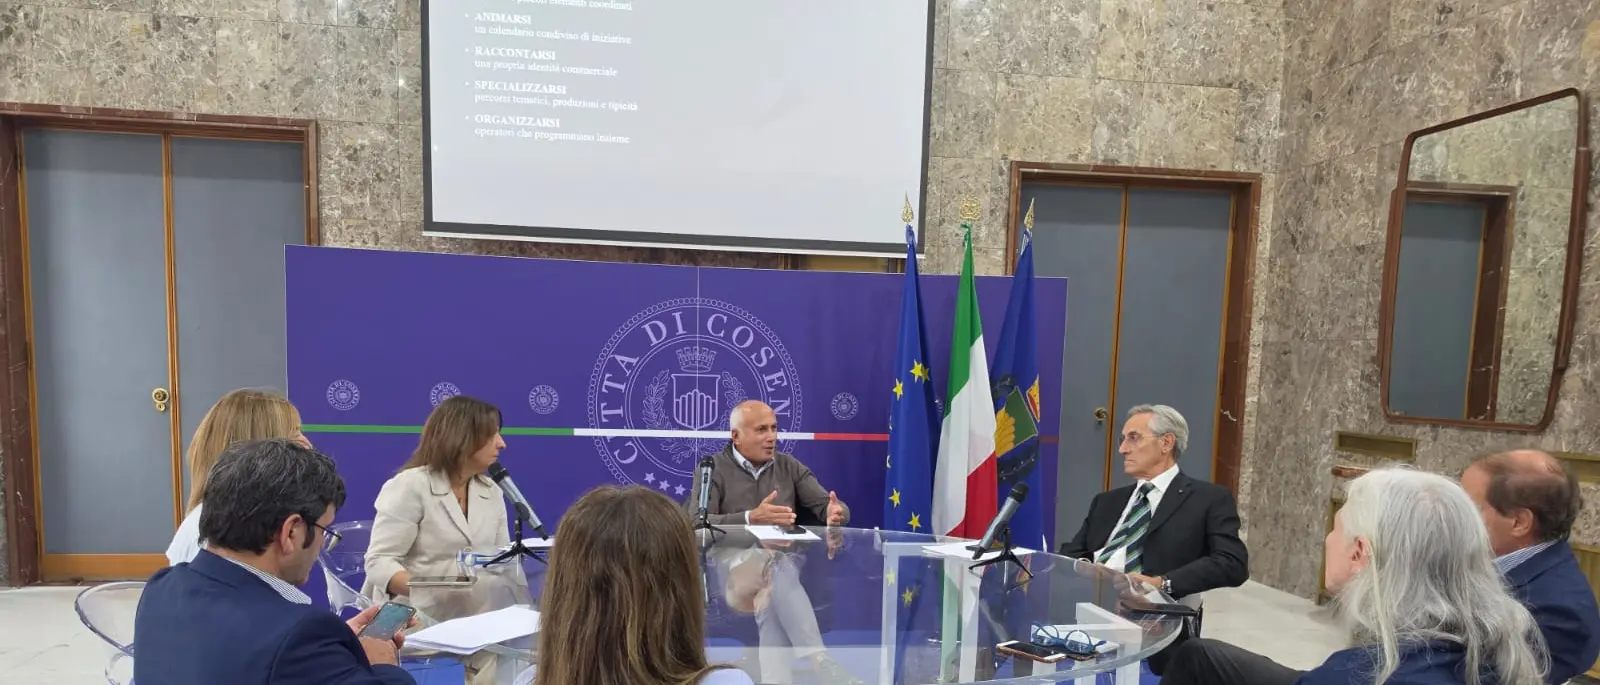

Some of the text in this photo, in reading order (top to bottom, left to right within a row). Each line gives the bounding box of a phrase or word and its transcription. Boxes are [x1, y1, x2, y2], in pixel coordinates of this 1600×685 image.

[474, 12, 532, 25] ANIMARSI
[474, 24, 632, 44] un calendario condiviso di iniziative
[474, 46, 556, 60] RACCONTARSI
[474, 60, 618, 77] una propria identità commerciale
[474, 80, 566, 95] SPECIALIZZARSI
[474, 94, 511, 104] percorsi
[552, 97, 599, 109] produzioni
[474, 113, 561, 128] ORGANIZZARSI
[474, 127, 515, 138] operatori
[516, 127, 533, 138] che
[596, 132, 631, 144] insieme
[601, 311, 791, 465] CTTÀ DI COSEN
